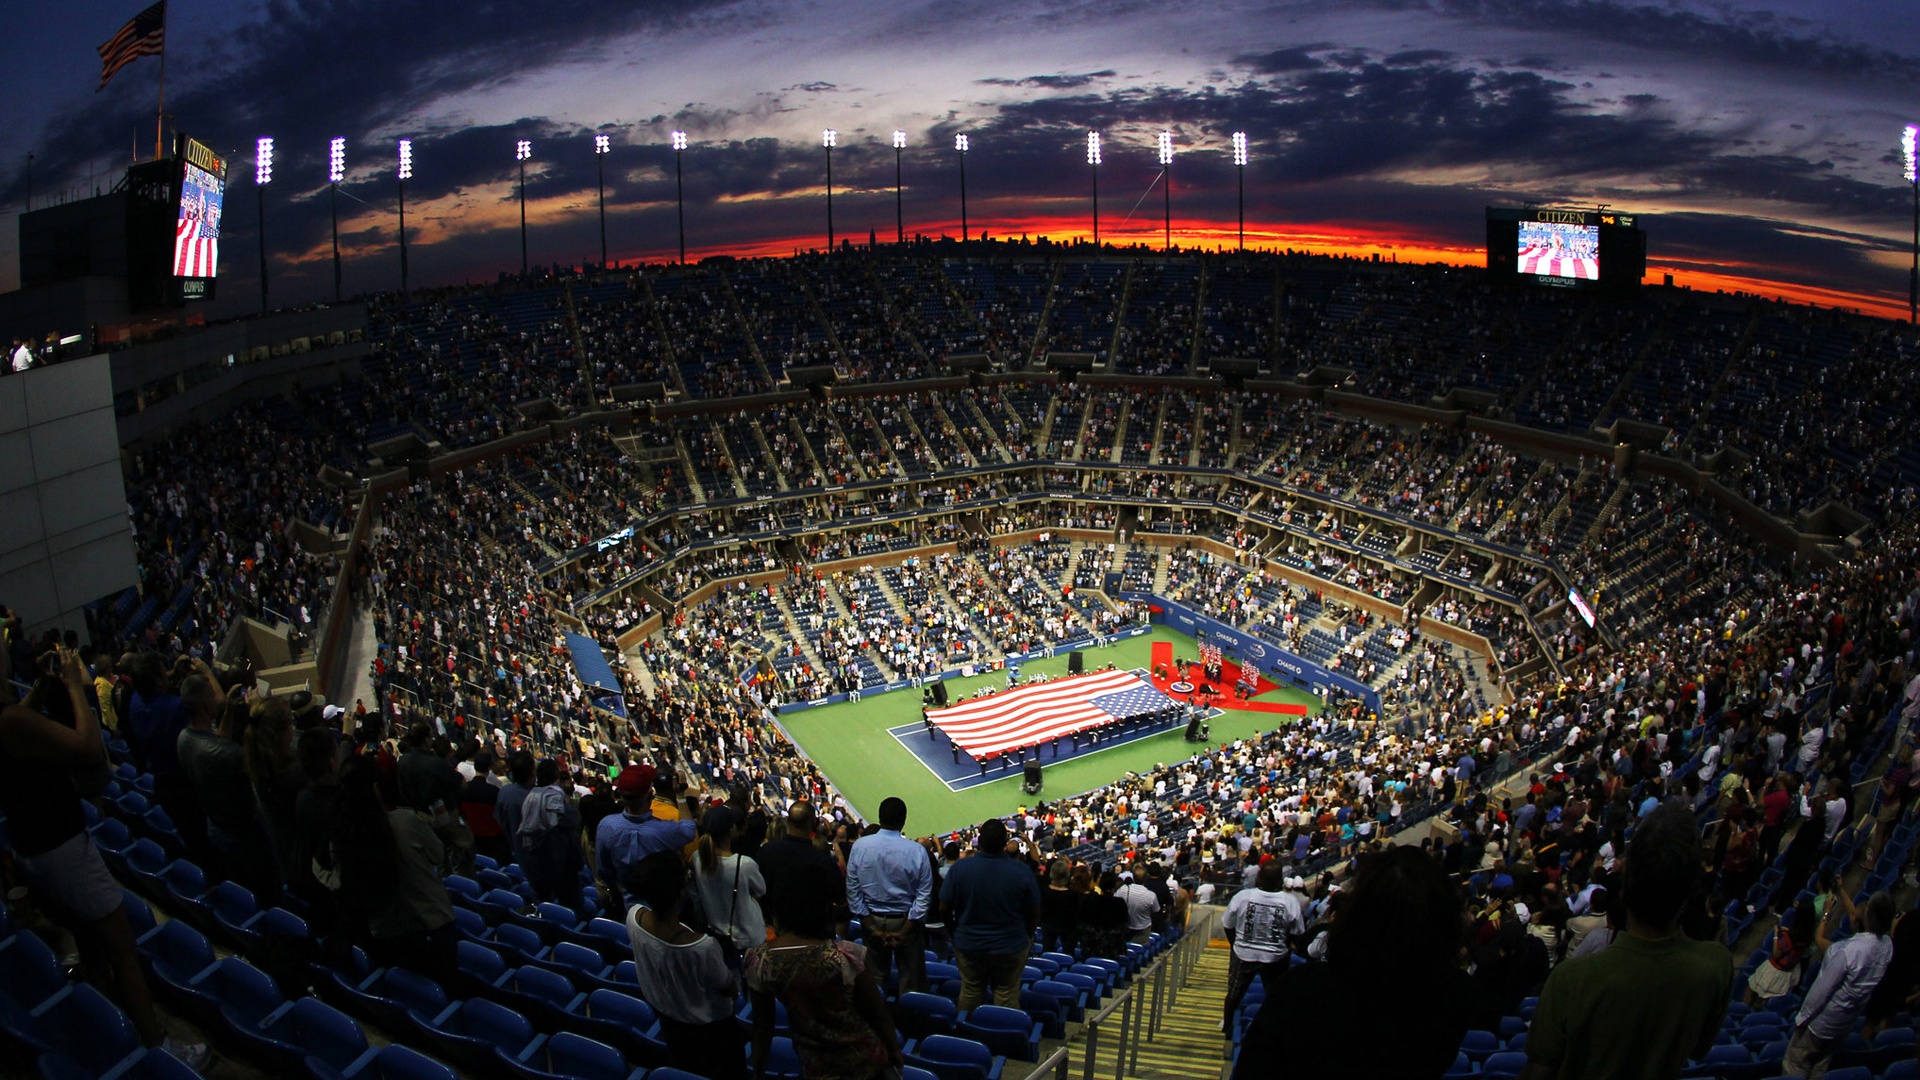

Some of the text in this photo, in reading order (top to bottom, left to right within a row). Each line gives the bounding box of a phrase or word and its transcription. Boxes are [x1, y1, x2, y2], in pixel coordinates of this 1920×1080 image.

[187, 138, 214, 170] CITIZEN
[1537, 211, 1585, 224] CITIZEN
[183, 280, 205, 293] OLYMPUS
[1538, 276, 1576, 285] OLYMPUS
[802, 525, 819, 533] CHASE
[1215, 631, 1233, 643] CHASE
[1276, 658, 1297, 672] CHASE
